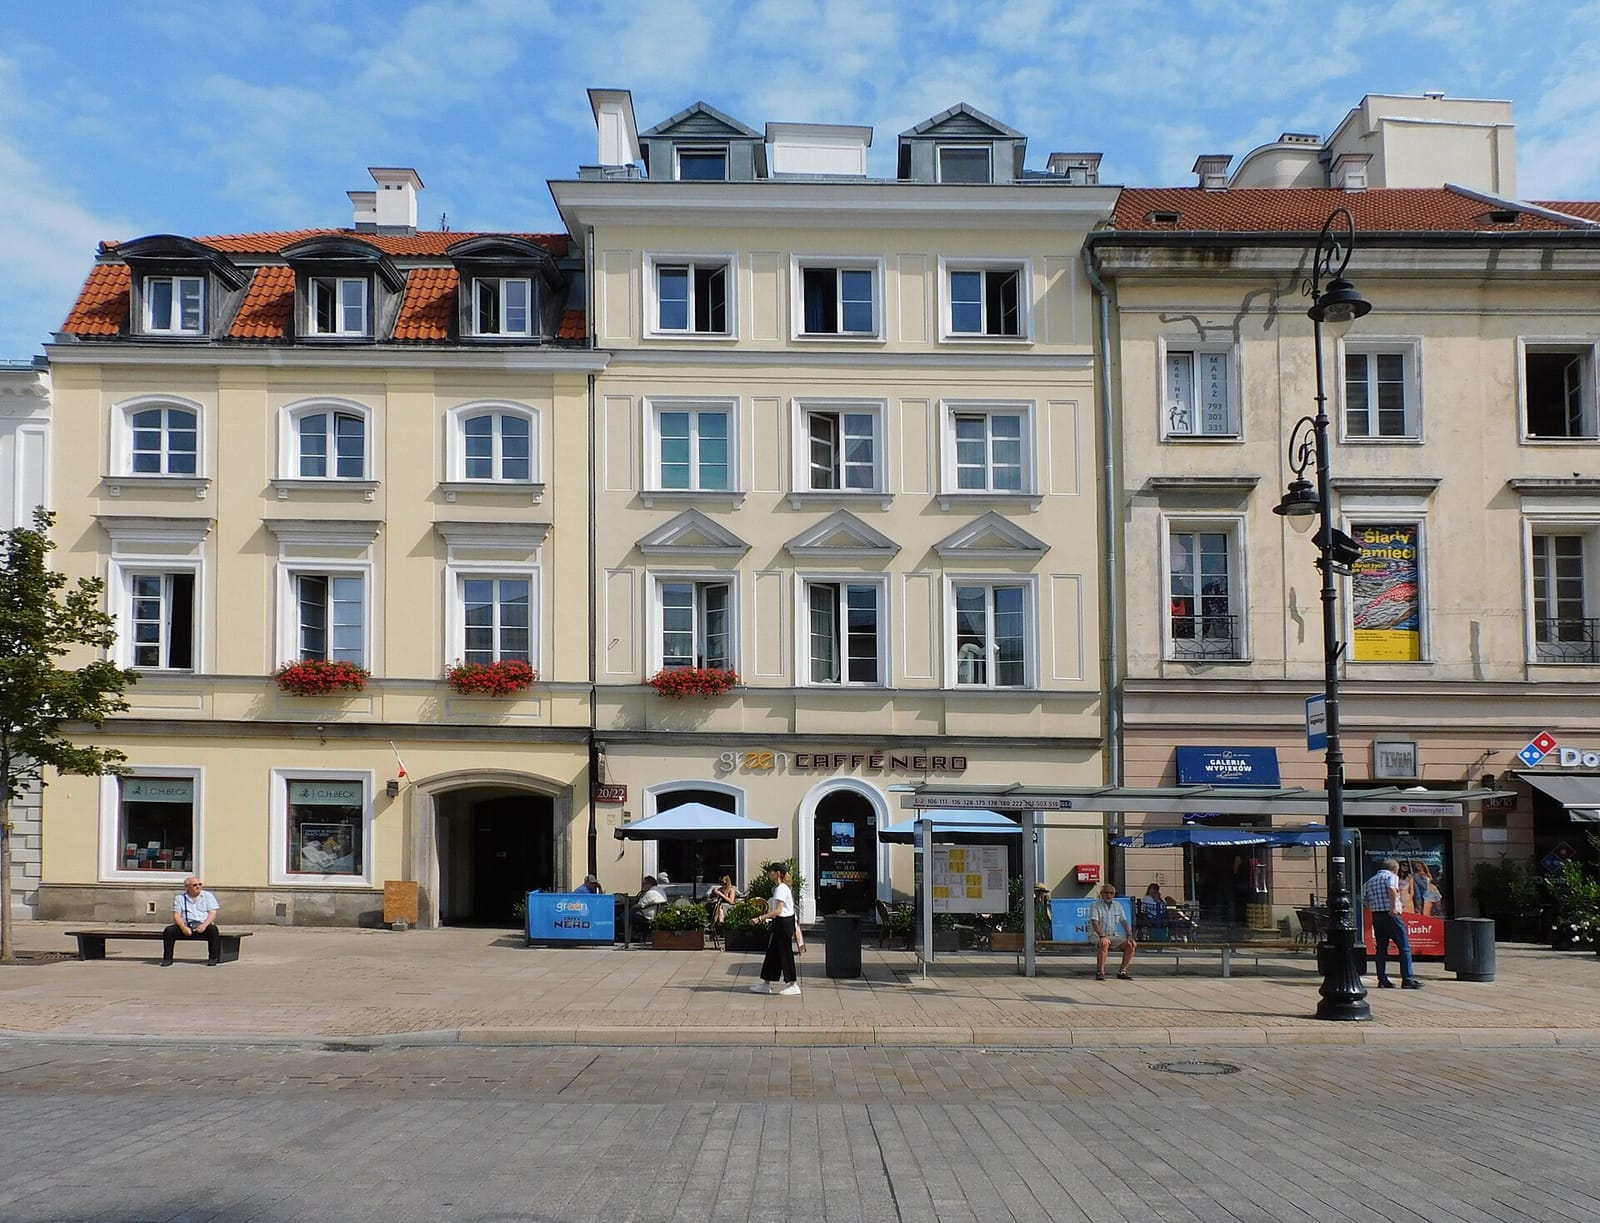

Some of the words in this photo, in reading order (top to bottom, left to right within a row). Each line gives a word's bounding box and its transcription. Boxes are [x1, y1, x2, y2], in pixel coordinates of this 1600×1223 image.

[1363, 528, 1411, 544] Ślady
[719, 751, 788, 771] green
[795, 750, 884, 769] CAFFÉ
[891, 755, 967, 771] NERO
[597, 786, 625, 799] 20/22
[1409, 807, 1445, 815] Uniwersytet
[555, 902, 588, 913] green
[553, 920, 591, 929] NERO
[1075, 925, 1090, 933] NE
